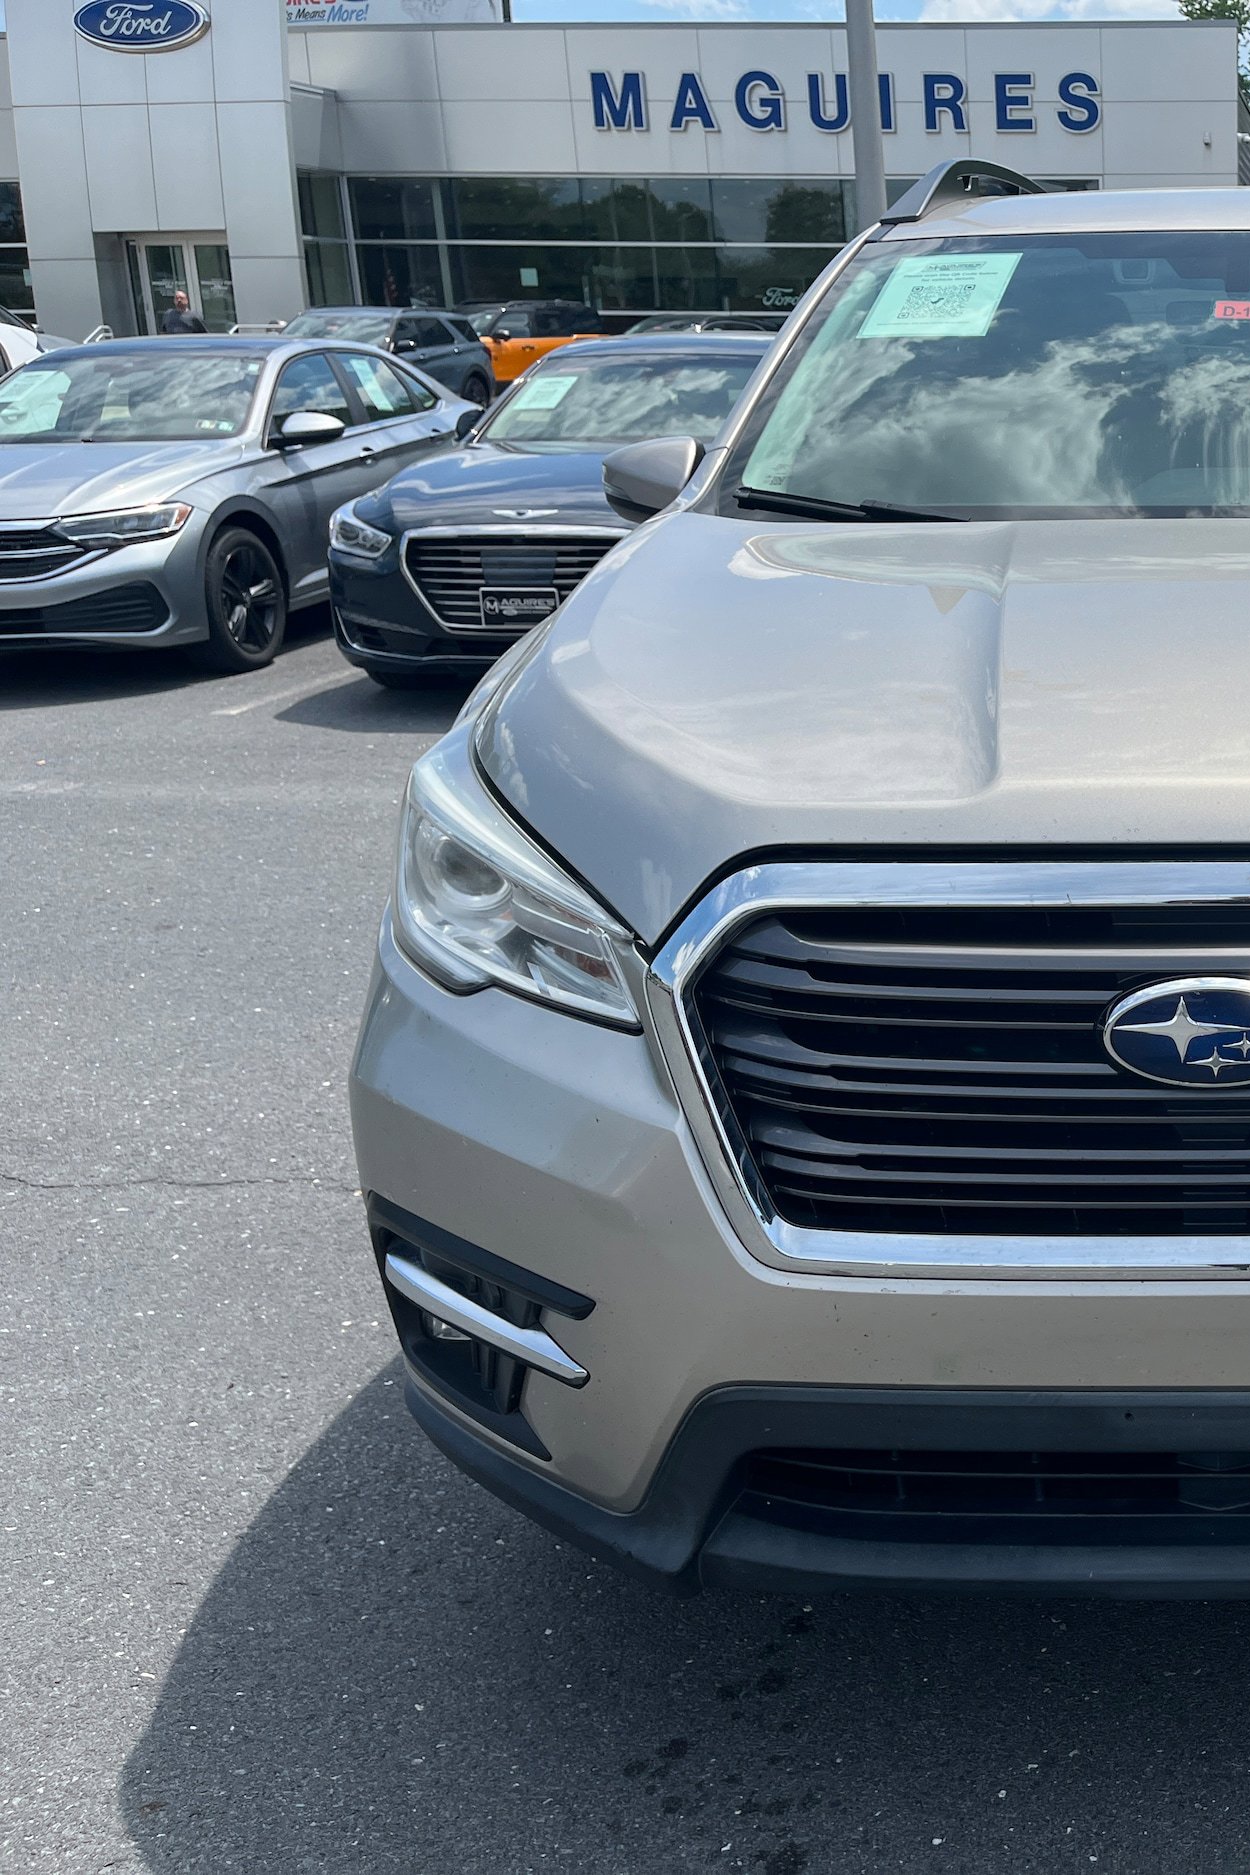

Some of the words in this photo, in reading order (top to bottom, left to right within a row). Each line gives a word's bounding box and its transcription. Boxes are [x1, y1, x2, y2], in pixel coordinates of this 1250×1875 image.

[100, 3, 172, 36] Ford
[295, 8, 326, 20] Means
[327, 4, 369, 22] More!
[590, 70, 1101, 132] MAGUIRES
